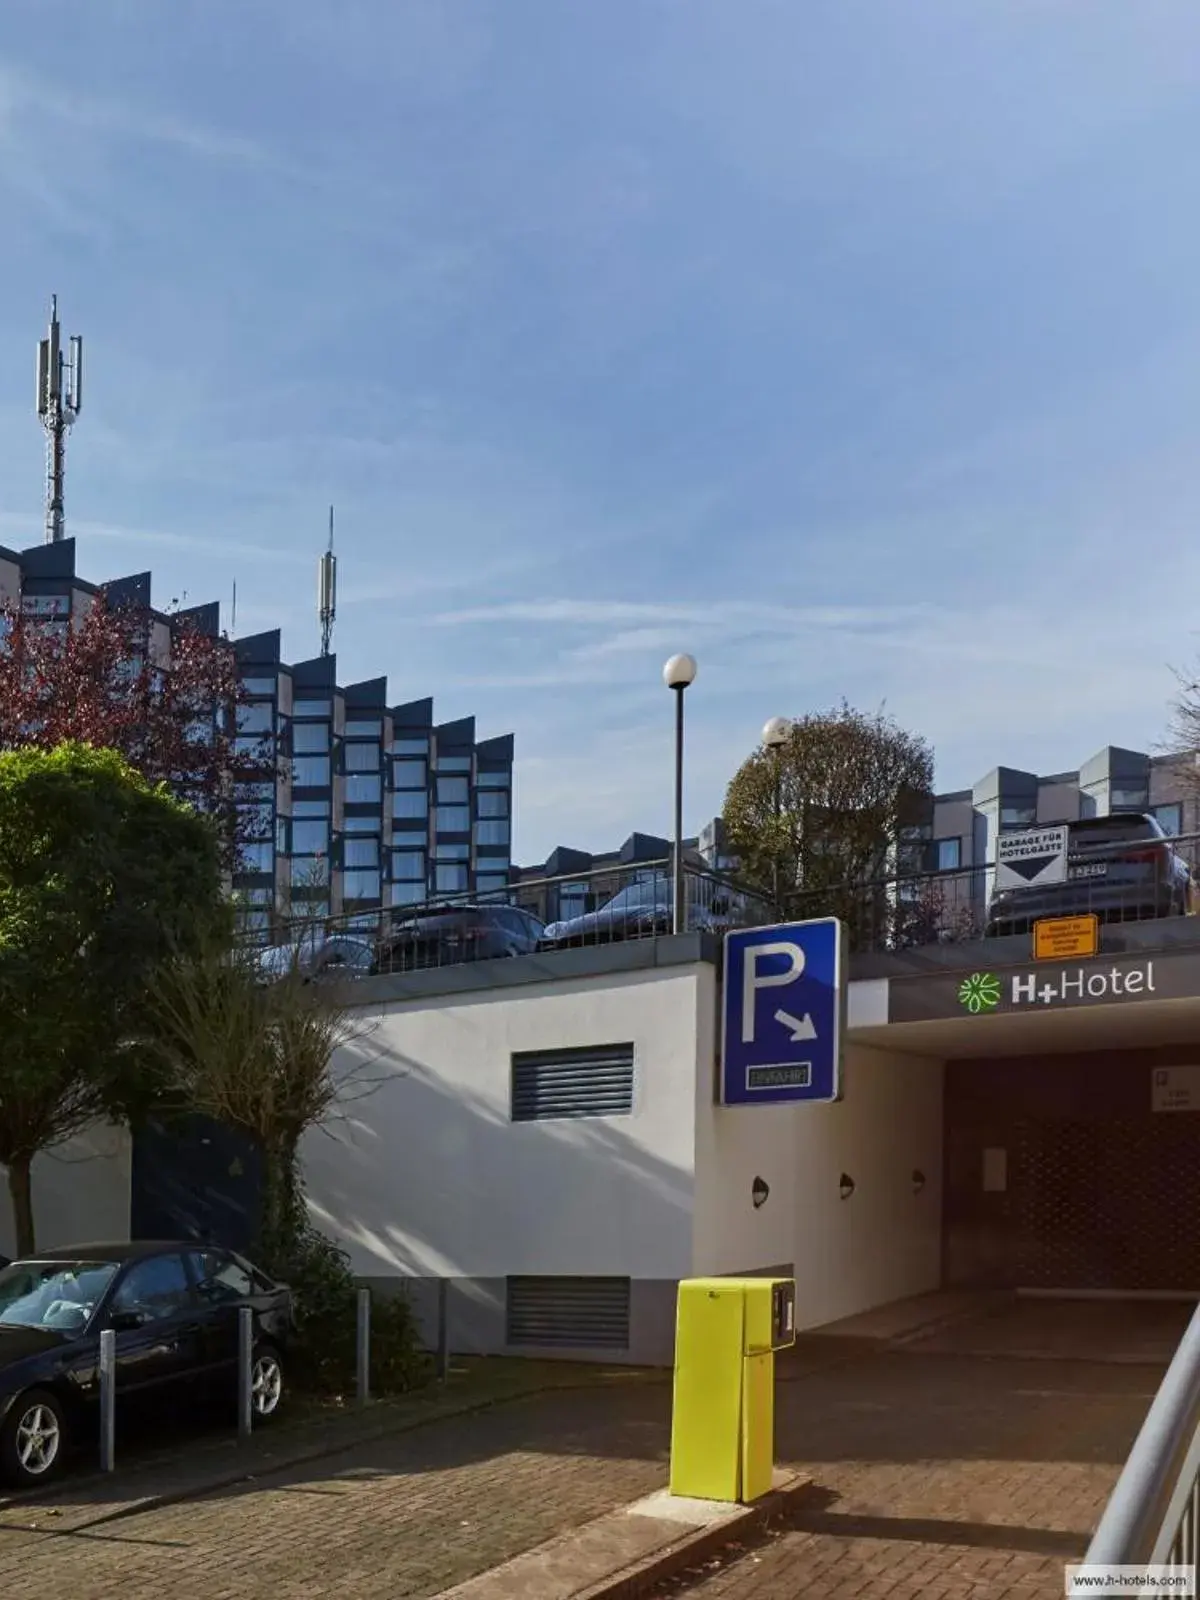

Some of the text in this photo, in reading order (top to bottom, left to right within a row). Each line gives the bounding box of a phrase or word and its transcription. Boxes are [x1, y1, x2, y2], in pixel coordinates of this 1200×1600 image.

[1001, 832, 1062, 849] GARAGE FÜR
[742, 942, 805, 1043] P
[1011, 961, 1155, 1004] H+Hotel
